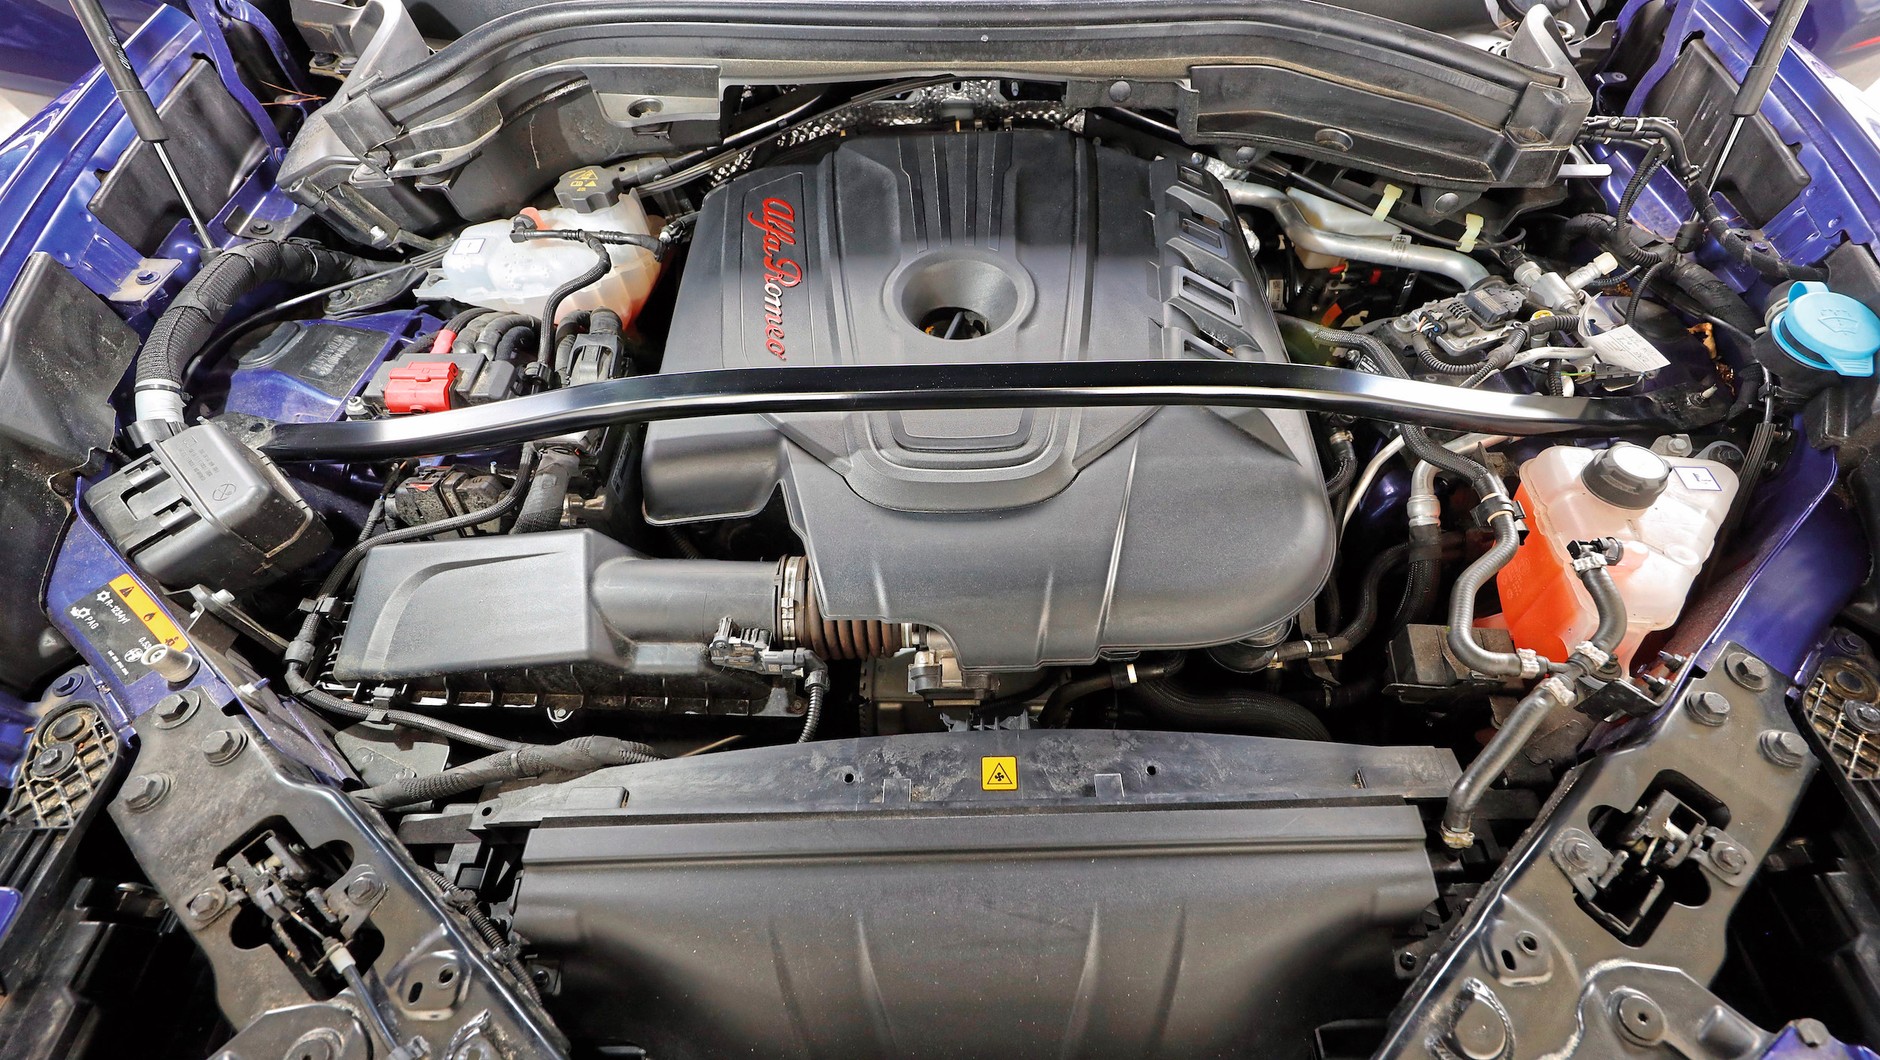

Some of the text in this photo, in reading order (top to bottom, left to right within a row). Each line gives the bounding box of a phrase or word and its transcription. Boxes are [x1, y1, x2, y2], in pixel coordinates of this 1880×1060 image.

[747, 197, 803, 361] Alfa Romeo
[84, 613, 99, 630] PAG
